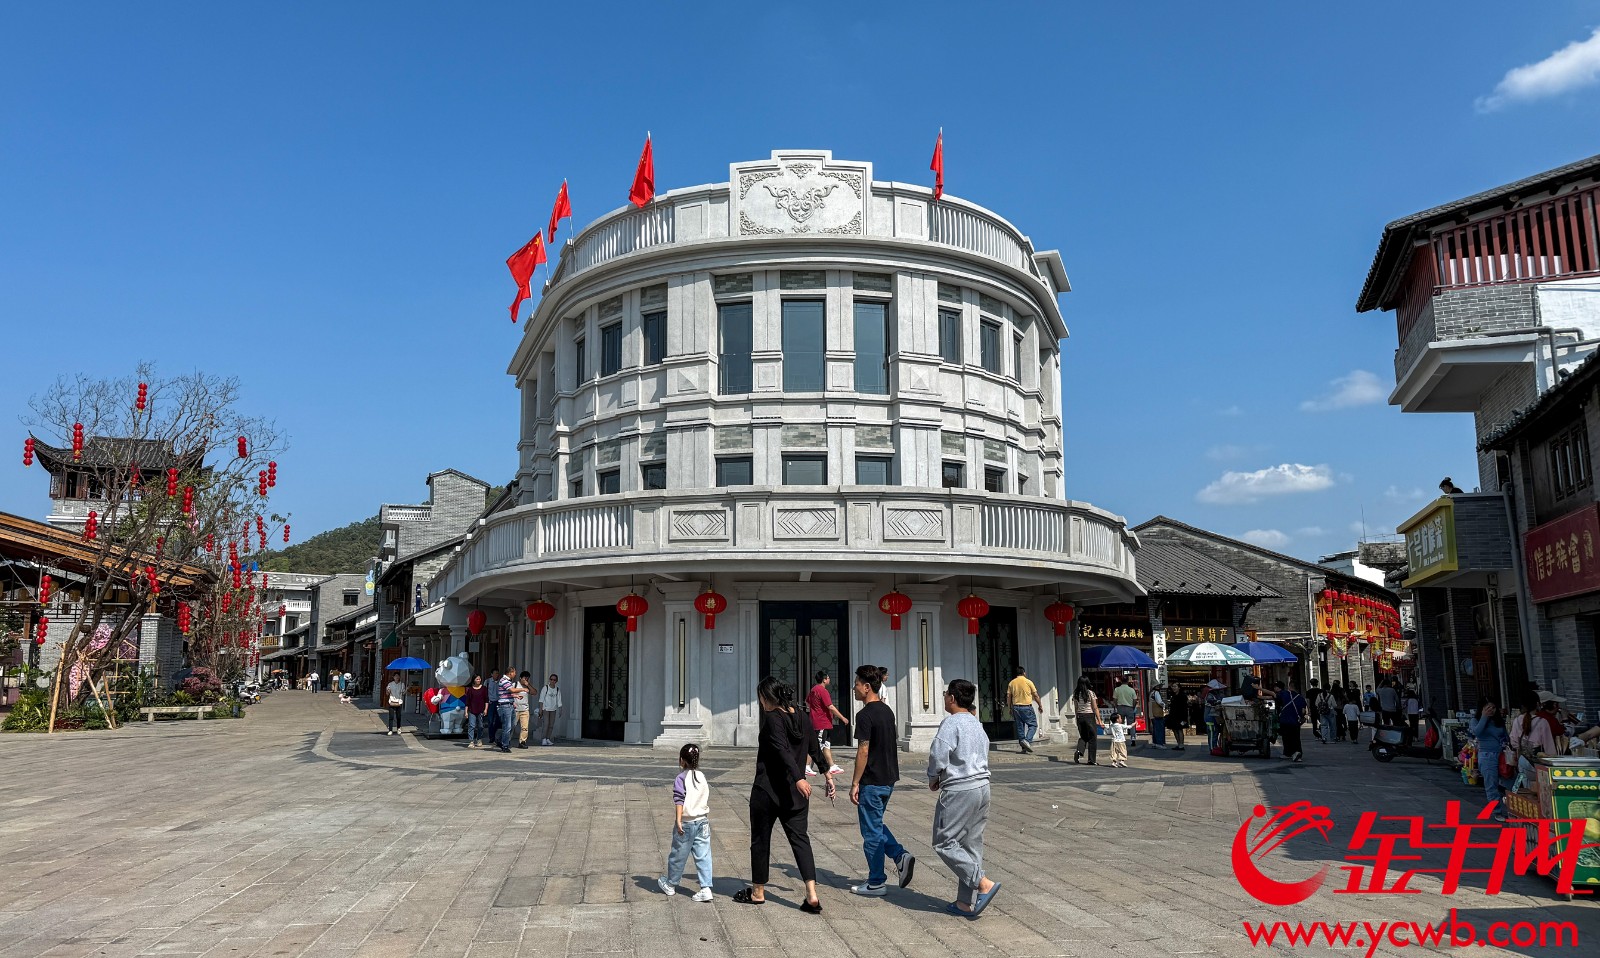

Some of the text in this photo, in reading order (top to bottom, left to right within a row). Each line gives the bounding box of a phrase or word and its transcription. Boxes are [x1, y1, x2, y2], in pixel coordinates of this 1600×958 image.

[1078, 624, 1094, 638] 記
[1164, 627, 1228, 642] 心兰正果特产
